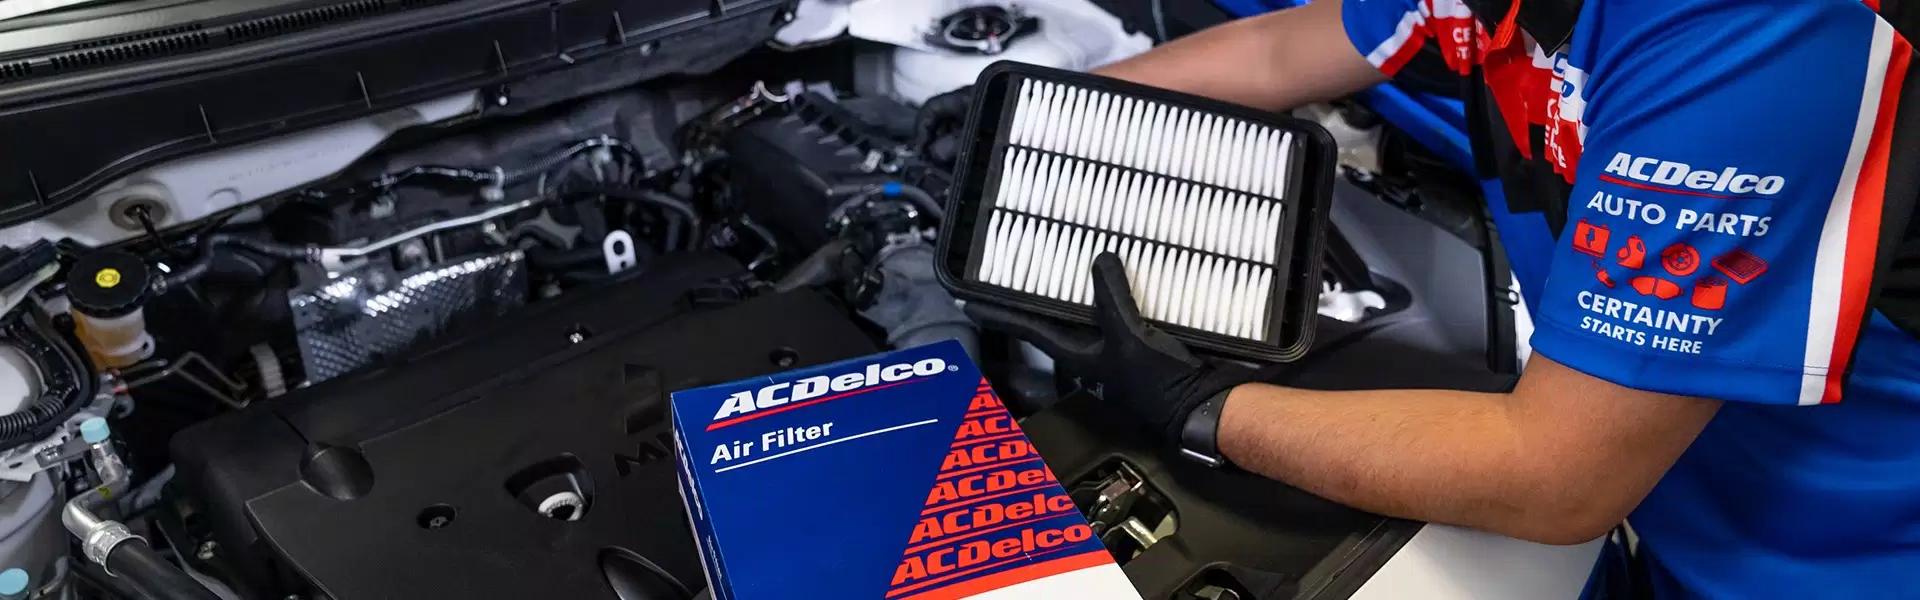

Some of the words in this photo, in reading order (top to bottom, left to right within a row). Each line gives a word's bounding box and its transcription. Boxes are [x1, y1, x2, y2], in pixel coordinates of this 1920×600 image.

[1604, 151, 1785, 195] ACDelco
[1586, 191, 1666, 225] AUTO
[1675, 208, 1772, 237] PARTS
[1577, 290, 1723, 335] CERTAINTY
[1580, 315, 1646, 346] STARTS
[1651, 334, 1703, 354] HERE
[713, 358, 946, 420] ACDelco
[710, 440, 754, 464] Air
[762, 421, 833, 452] Filter
[890, 524, 1092, 587] ACDelco
